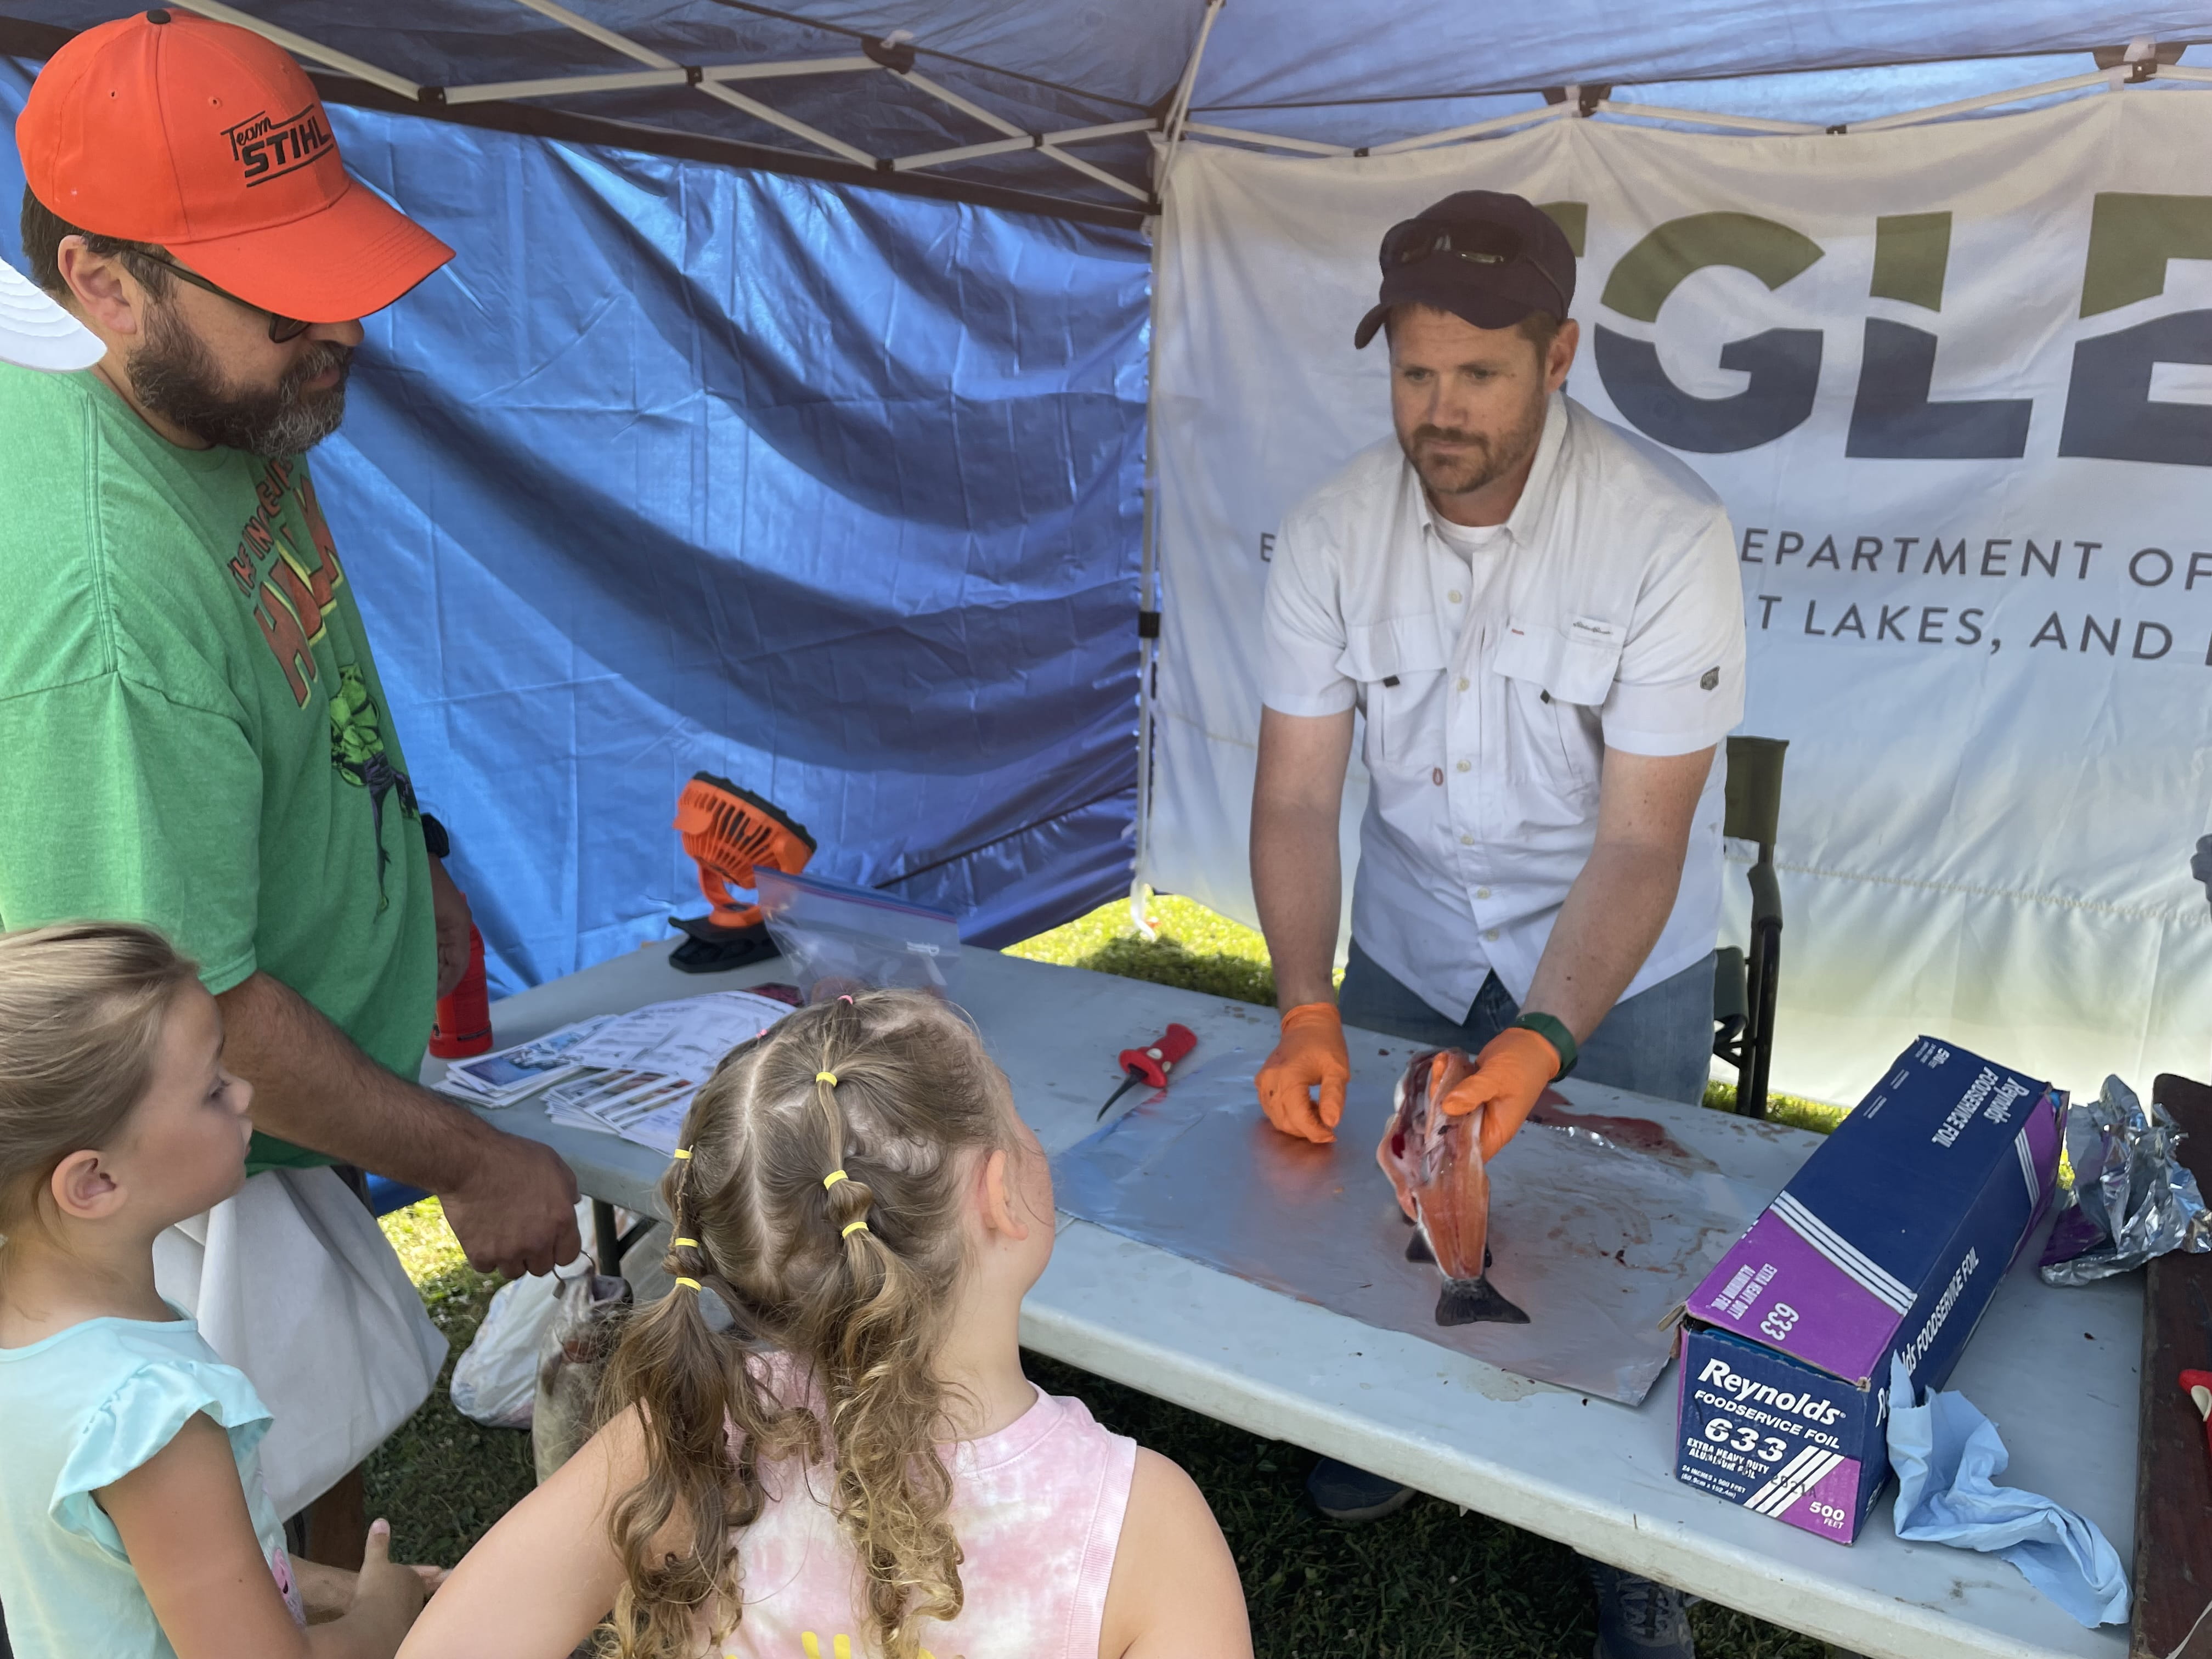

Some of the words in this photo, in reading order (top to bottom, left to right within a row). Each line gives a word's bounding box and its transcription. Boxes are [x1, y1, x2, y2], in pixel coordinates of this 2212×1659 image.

[221, 108, 291, 160] Team
[241, 116, 332, 178] STIHL
[1533, 190, 2212, 467] GLE
[1741, 527, 2102, 581] EPARTMENT
[2129, 547, 2212, 591] OF
[1804, 599, 2002, 656] LAKES,
[2030, 612, 2173, 661] AND
[1946, 1066, 1999, 1130] FOODSERVICE
[1931, 1122, 1960, 1148] FOIL
[1760, 1302, 1799, 1341] 633
[1916, 1267, 1964, 1360] FOODSERVICE
[1962, 1246, 1979, 1283] FOIL
[1694, 1390, 1803, 1436] FOODSERVICE
[1804, 1429, 1840, 1449] FOIL
[1705, 1418, 1787, 1462] 633
[1686, 1437, 1714, 1453] EXTRA
[1716, 1448, 1745, 1465] HEAVY
[1746, 1459, 1770, 1474] DUTY
[1690, 1467, 1713, 1482] INCHES
[1730, 1483, 1747, 1494] FEET
[1809, 1501, 1846, 1521] 500
[1823, 1517, 1844, 1530] FEET
